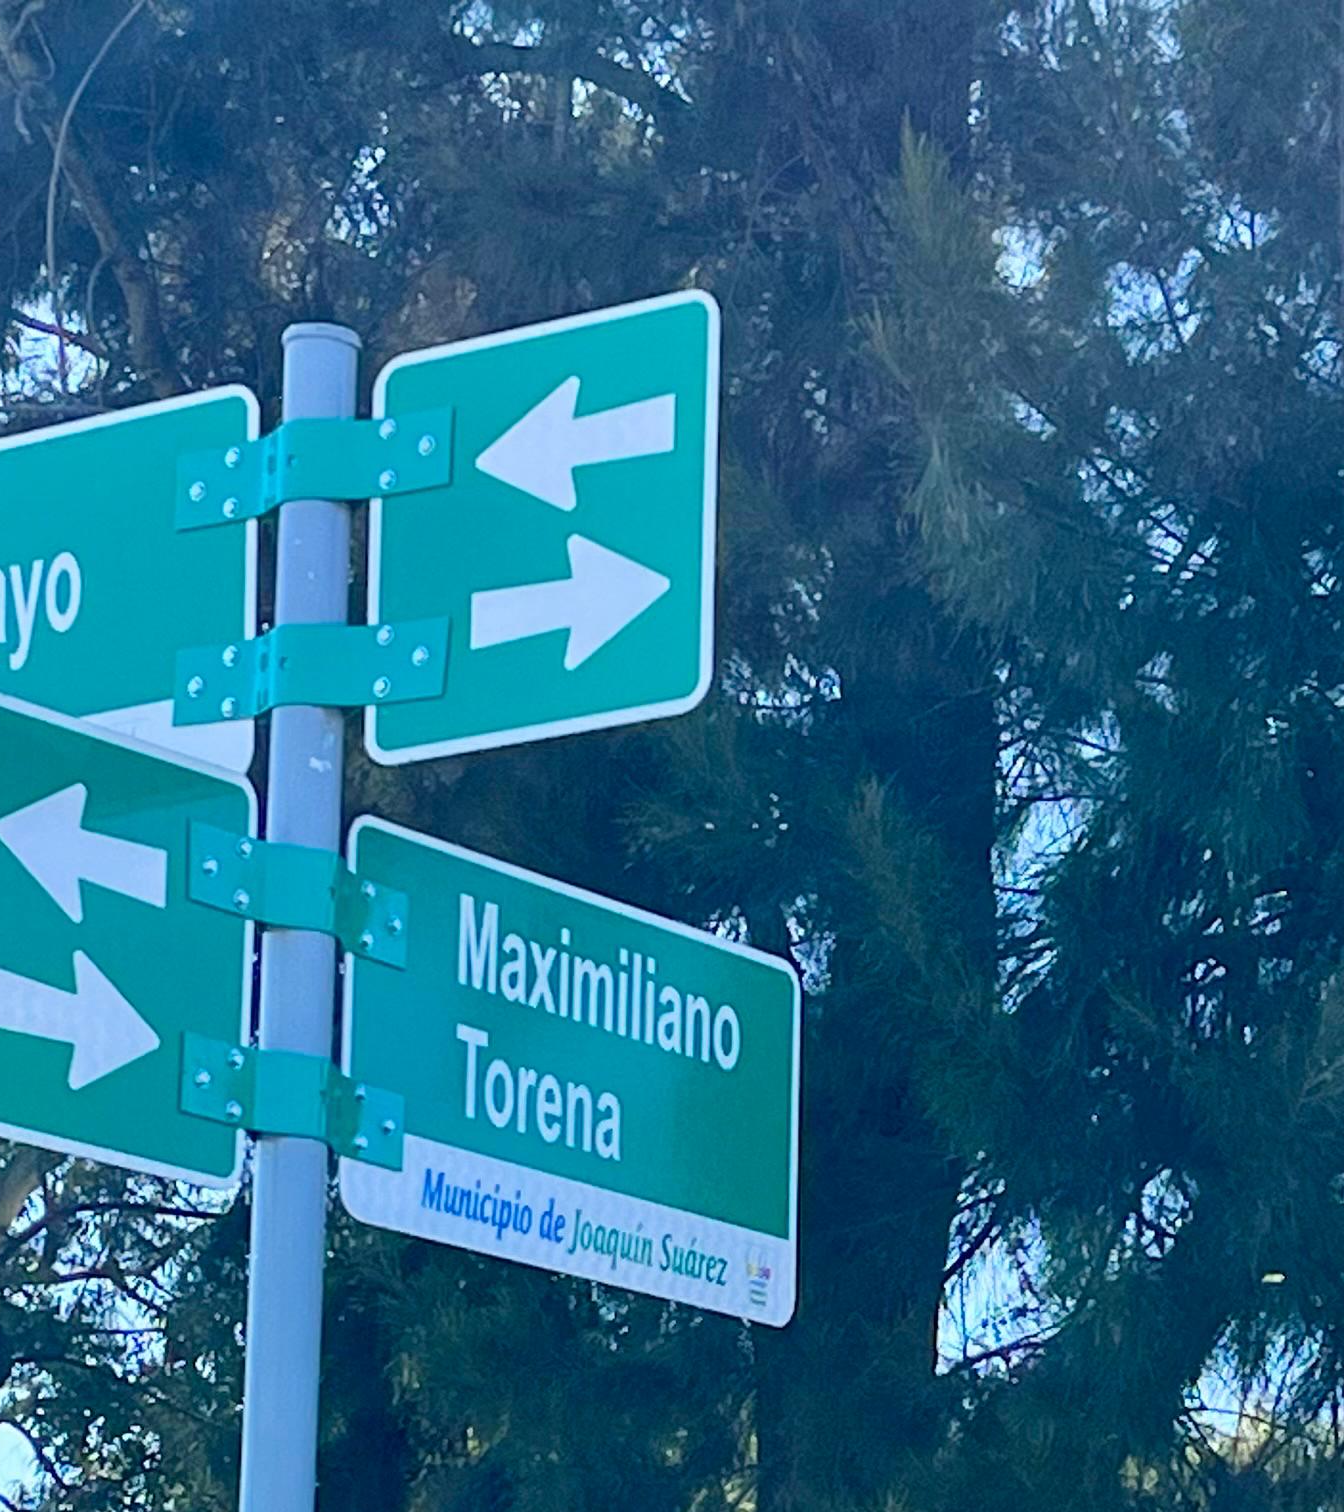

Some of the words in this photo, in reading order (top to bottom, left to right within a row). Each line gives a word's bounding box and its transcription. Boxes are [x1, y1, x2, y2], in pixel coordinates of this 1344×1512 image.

[459, 893, 740, 1071] Maximiliano
[457, 1023, 621, 1161] Torena
[421, 1168, 533, 1240] Municipio
[539, 1198, 566, 1243] de
[568, 1208, 654, 1270] Joaquín
[659, 1233, 728, 1286] Suárez
